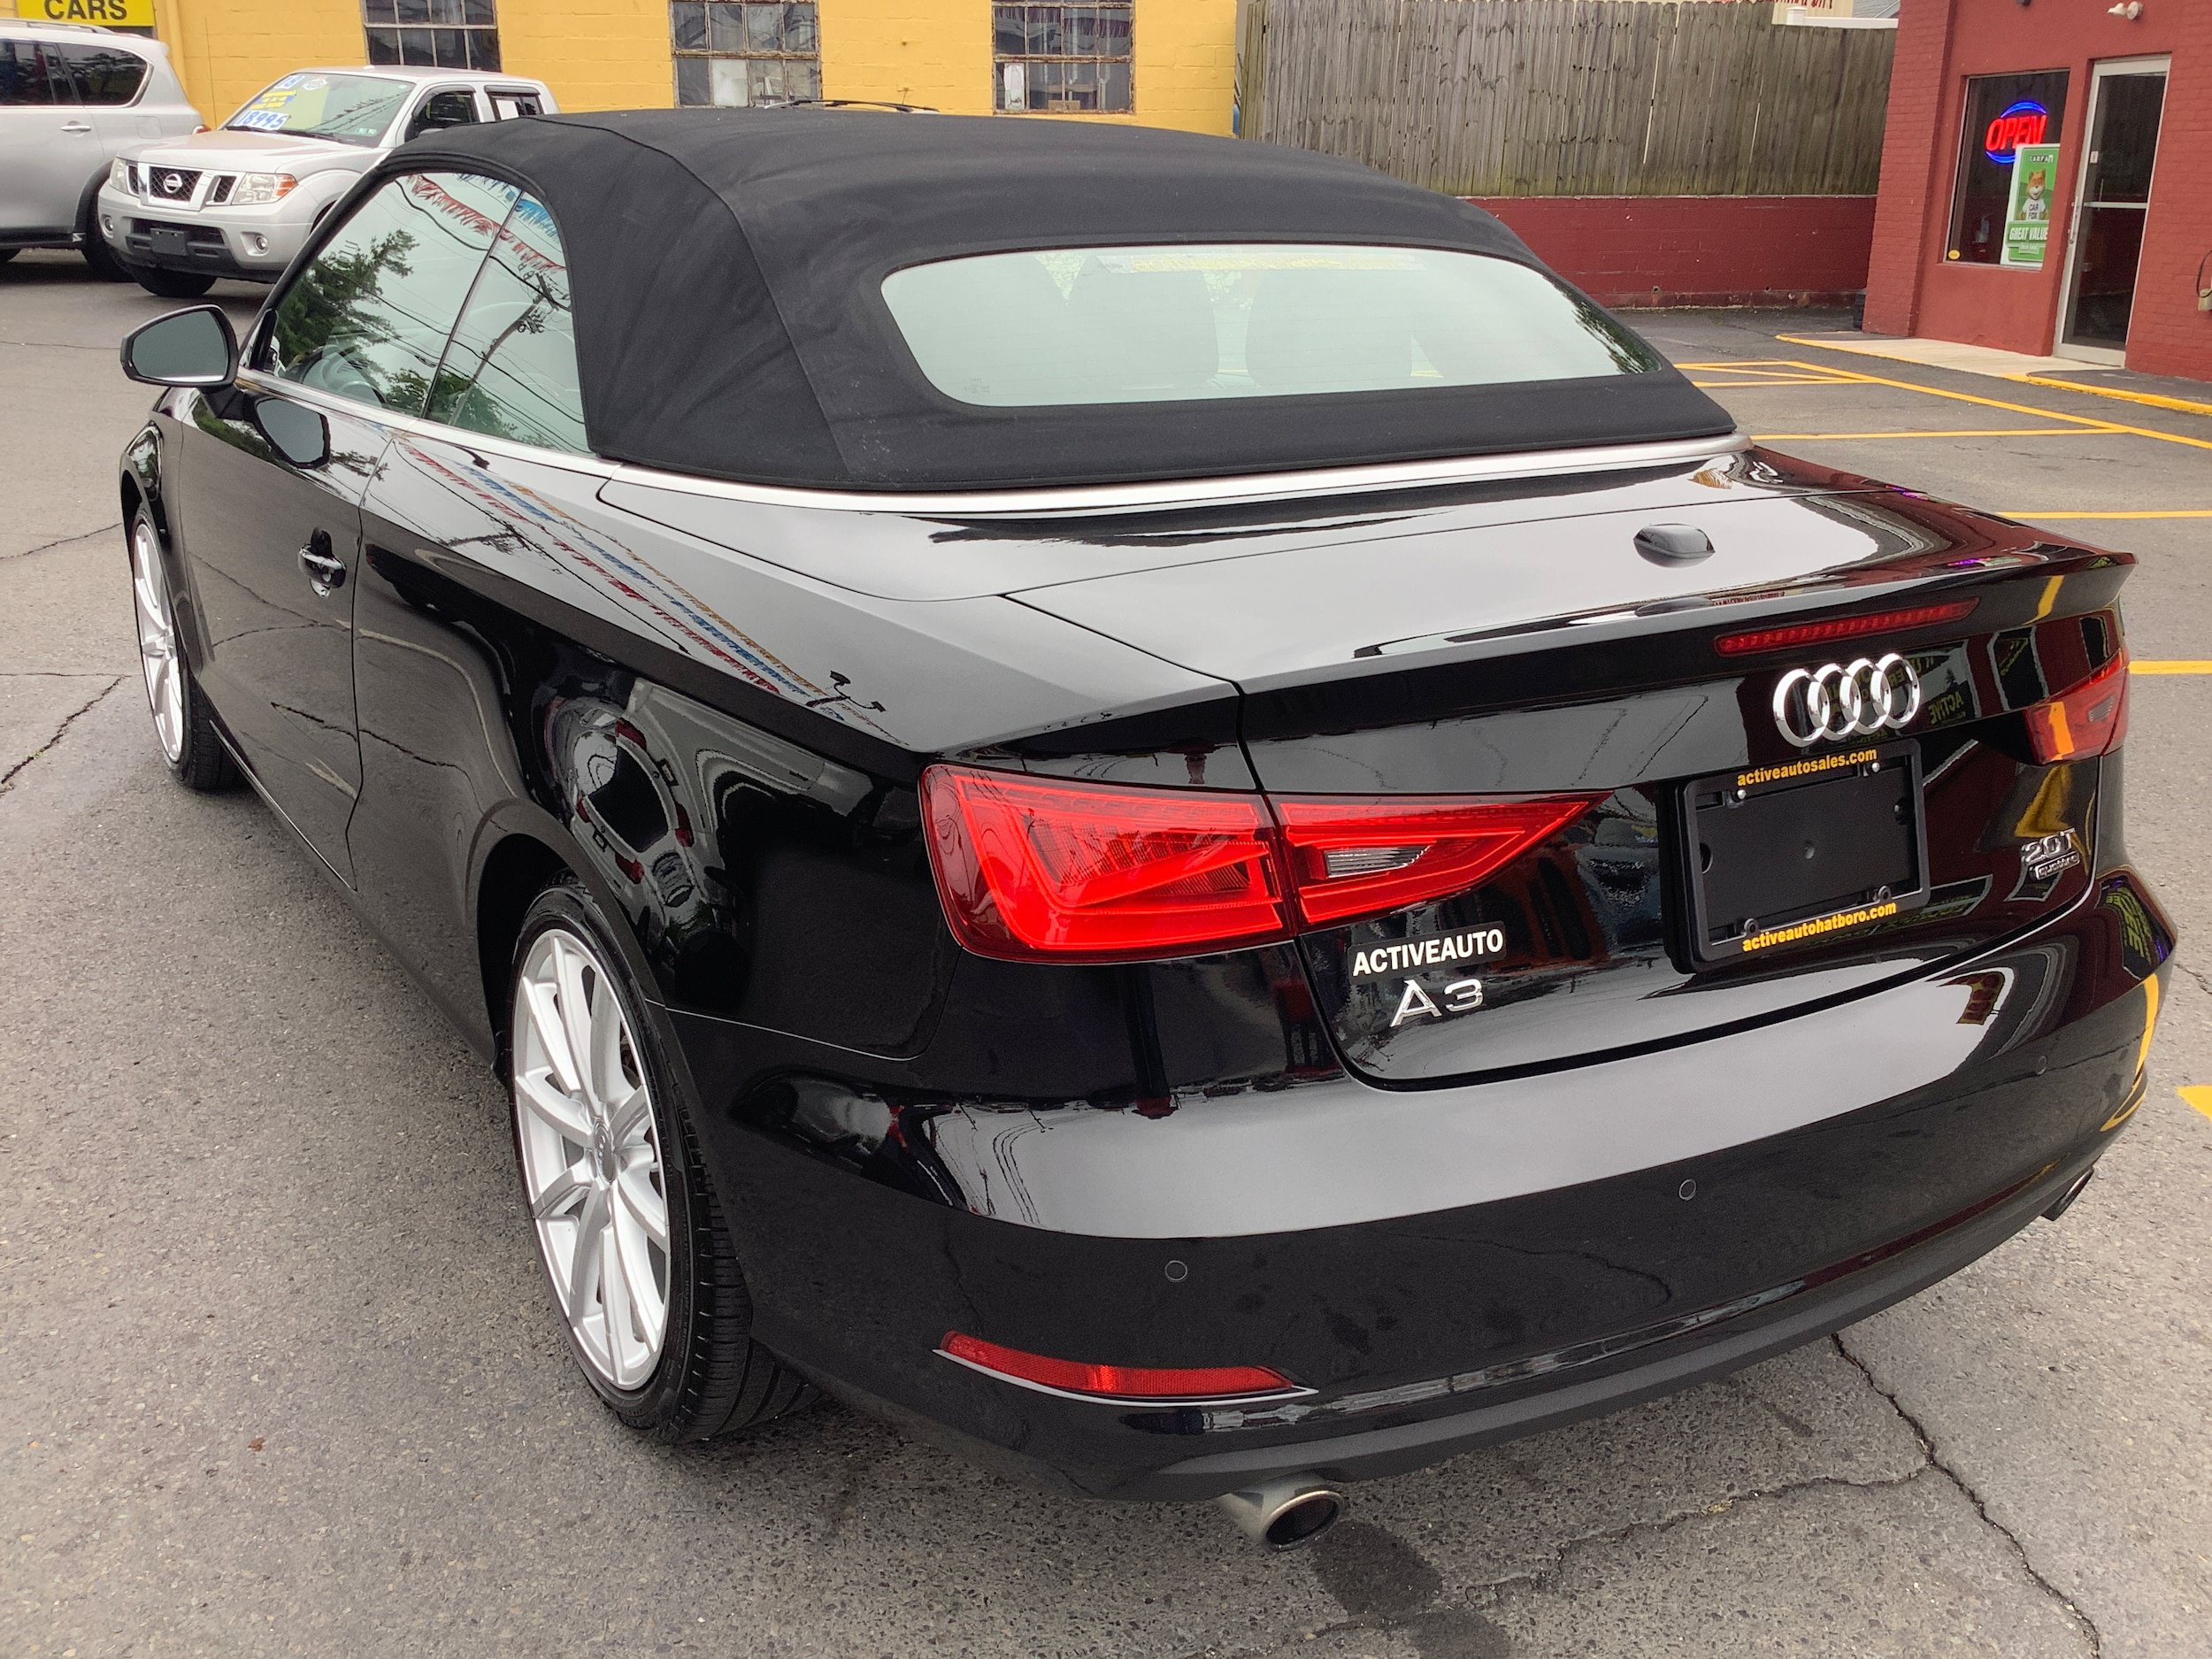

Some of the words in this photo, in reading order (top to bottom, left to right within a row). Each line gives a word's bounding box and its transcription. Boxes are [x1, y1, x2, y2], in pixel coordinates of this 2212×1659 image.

[44, 0, 127, 19] CARS
[235, 111, 288, 128] 18995
[1985, 114, 2047, 150] OPEN
[2009, 227, 2030, 241] GREAT
[1737, 749, 1878, 786] activeautosales.com
[1742, 902, 1897, 952] activeautohatboro.com
[1353, 928, 1503, 976] ACTIVEAUTO
[1389, 978, 1484, 1028] A3
